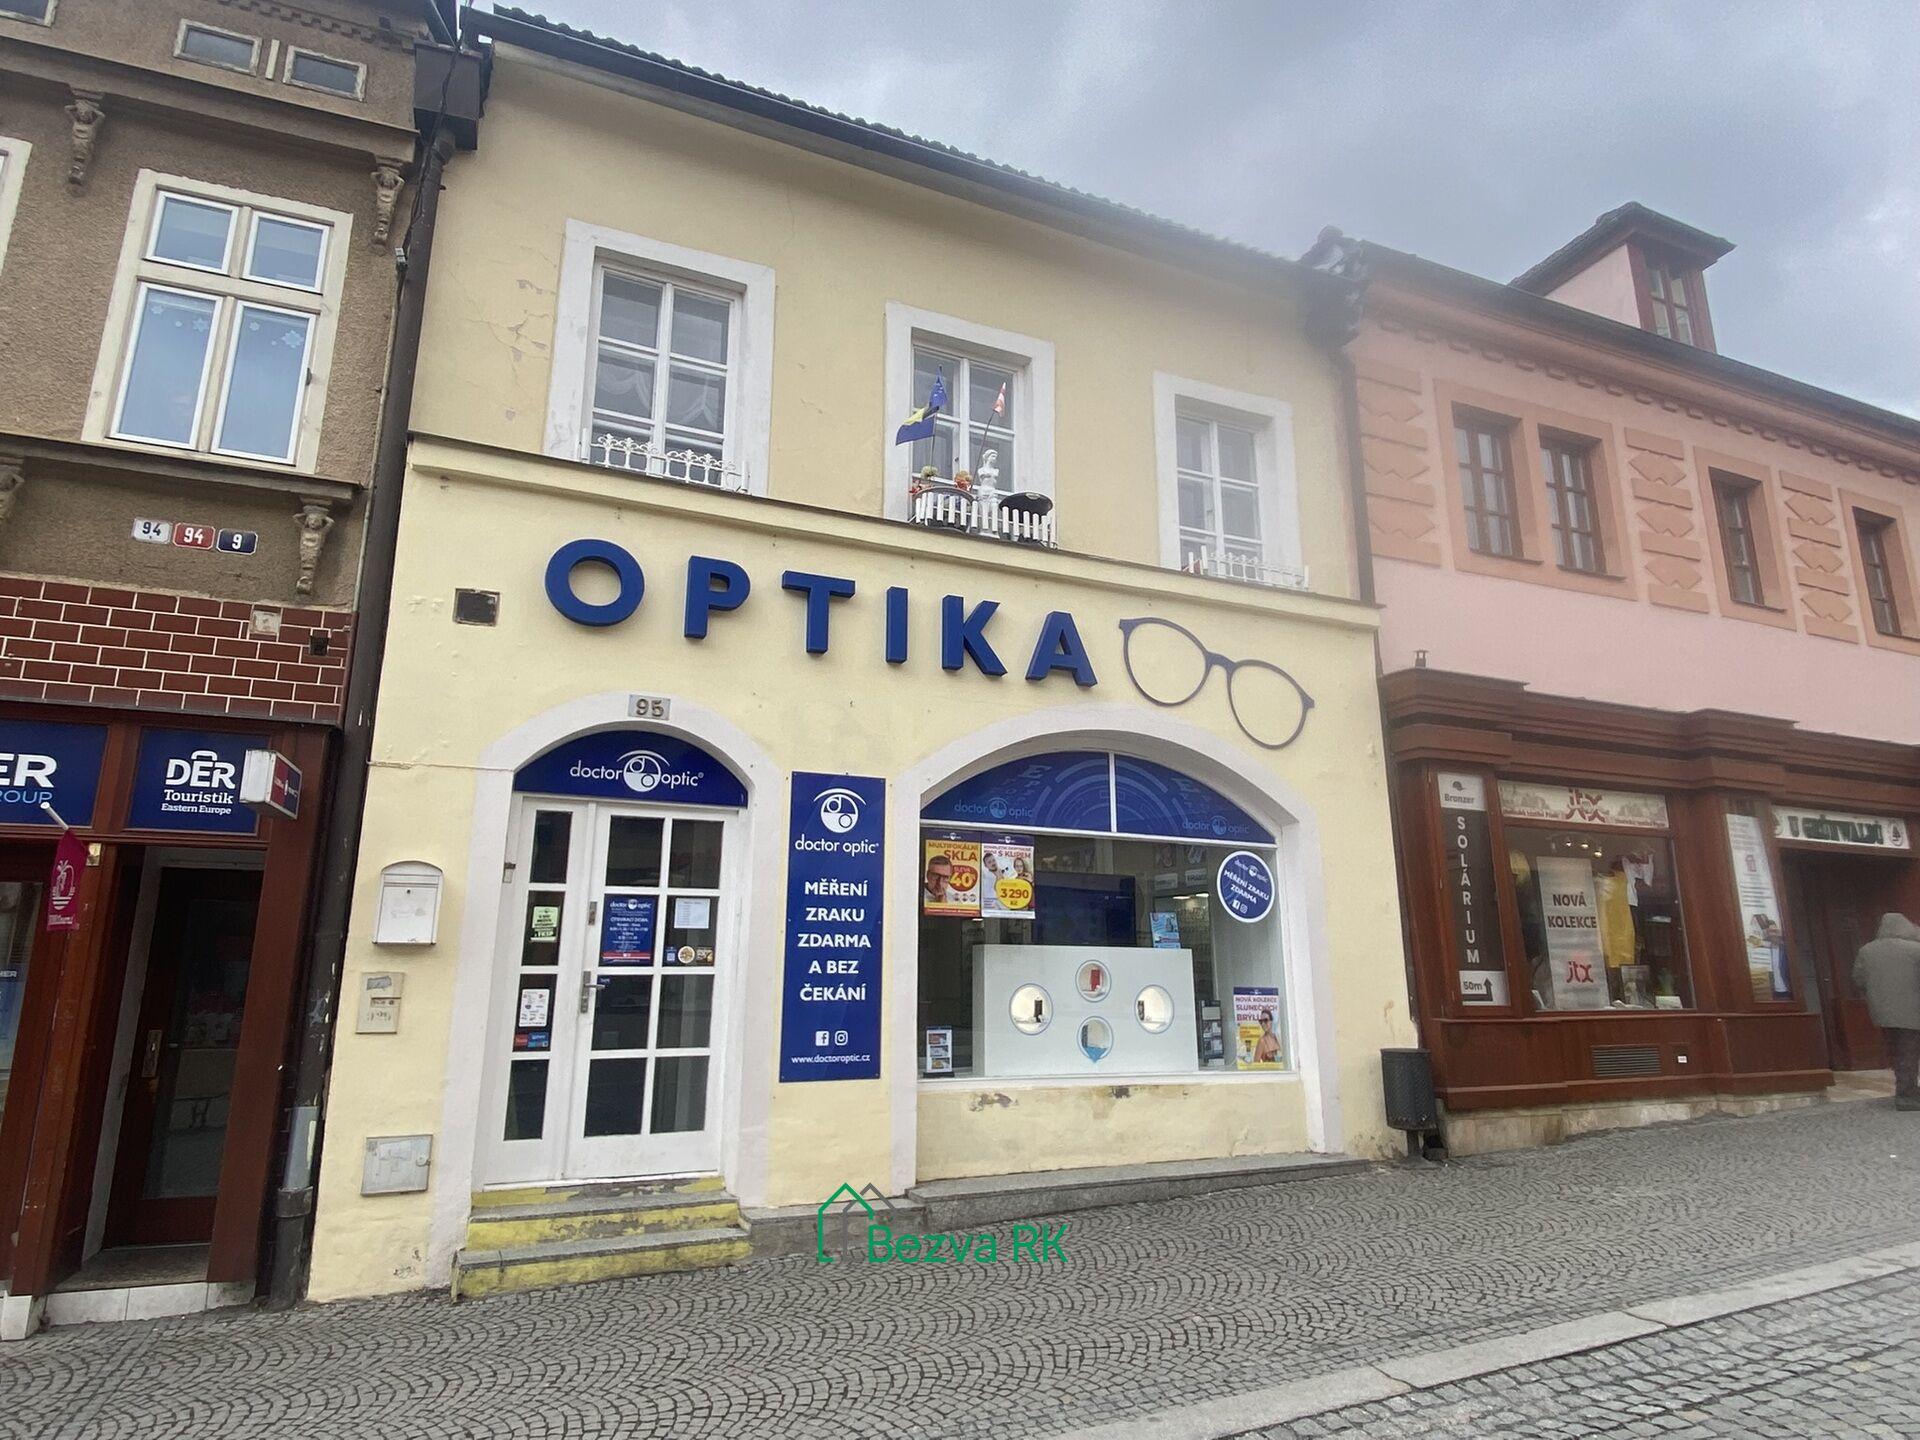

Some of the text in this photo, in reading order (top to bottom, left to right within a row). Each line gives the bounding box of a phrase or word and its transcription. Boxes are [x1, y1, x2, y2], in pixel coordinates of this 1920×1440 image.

[142, 521, 161, 536] 94
[183, 527, 204, 545] 94
[231, 533, 243, 550] 9
[545, 539, 1098, 687] OPTIKA
[636, 698, 664, 718] 95
[165, 758, 236, 790] DER
[569, 760, 622, 780] doctor
[0, 790, 52, 804] OUP
[164, 789, 235, 805] Touristik
[1444, 793, 1474, 805] Bronzer
[161, 803, 232, 815] Eastern Europe
[954, 800, 988, 814] doctor
[1182, 819, 1210, 831] doctor
[795, 834, 840, 851] doctor
[944, 849, 978, 861] SKLA
[804, 878, 868, 896] MĚŘENÍ
[1223, 869, 1248, 888] MĚŘENÍ
[1247, 883, 1270, 901] ZRAKU
[1457, 816, 1481, 964] SOLÁRIUM
[1230, 883, 1257, 904] ZDARMA
[1553, 891, 1587, 908] NOVÁ
[805, 907, 865, 922] ZRAKU
[1547, 915, 1597, 929] KOLEKCE
[797, 933, 872, 948] ZDARMA
[808, 960, 859, 974] A BEZ
[1566, 960, 1594, 984] jtx
[799, 983, 866, 1002] ČEKÁNÍ
[1463, 980, 1483, 991] 50m
[790, 1053, 871, 1065] www.doctoroptic.cz
